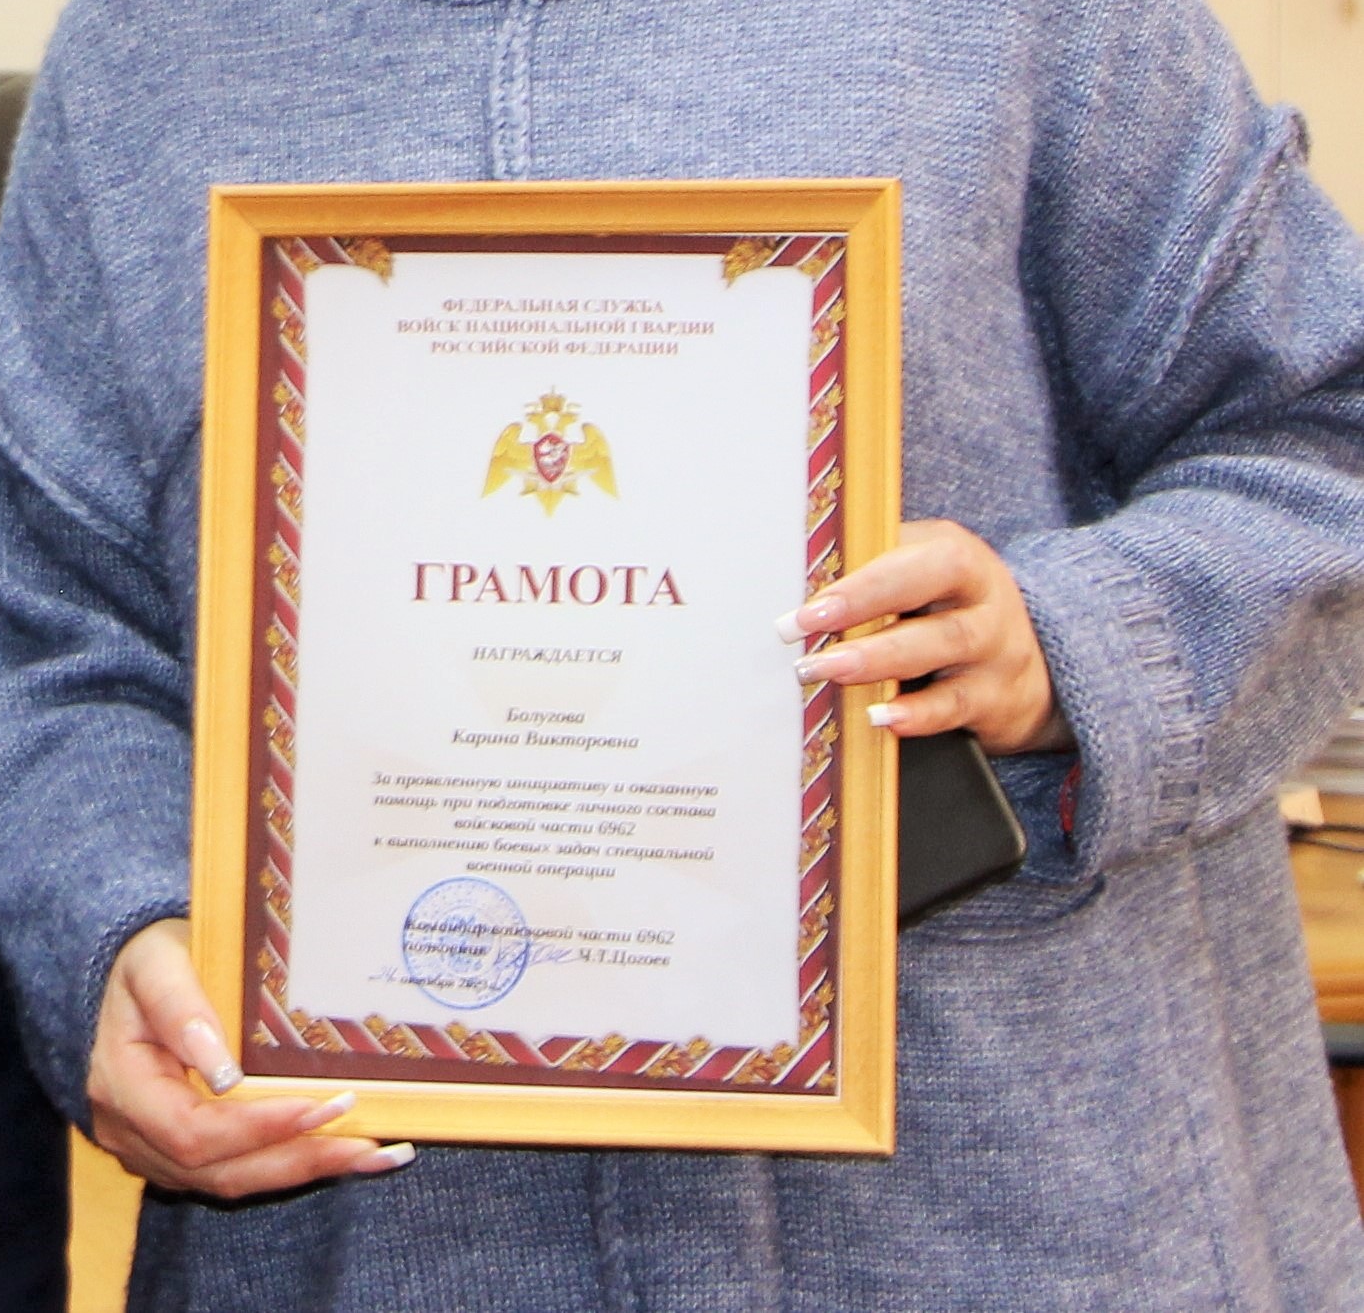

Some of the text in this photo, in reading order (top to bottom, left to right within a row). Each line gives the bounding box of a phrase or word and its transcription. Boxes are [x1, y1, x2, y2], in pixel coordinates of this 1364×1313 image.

[397, 318, 716, 336] ВОЙСК НАЦИОНАЛЬНОЙ ГВАРДИИ
[430, 339, 680, 356] РОССИЙСКОЙ ФЕДЕРАЦИИ
[411, 561, 688, 606] ГРАМОТА
[472, 646, 623, 665] НАГРАЖДАЕТСЯ
[451, 728, 640, 752] Карина Викторовна
[373, 772, 720, 799] За проявленную инициативу и оказанную
[373, 793, 718, 818] помощь при подготовке личного состава
[453, 817, 638, 836] войсковой части 6962
[387, 836, 490, 851] выполнению
[493, 837, 551, 853] боевых
[556, 841, 601, 855] задач
[605, 845, 715, 862] специальной
[465, 859, 617, 879] военной операции
[578, 929, 632, 943] части
[636, 929, 676, 945] 6962
